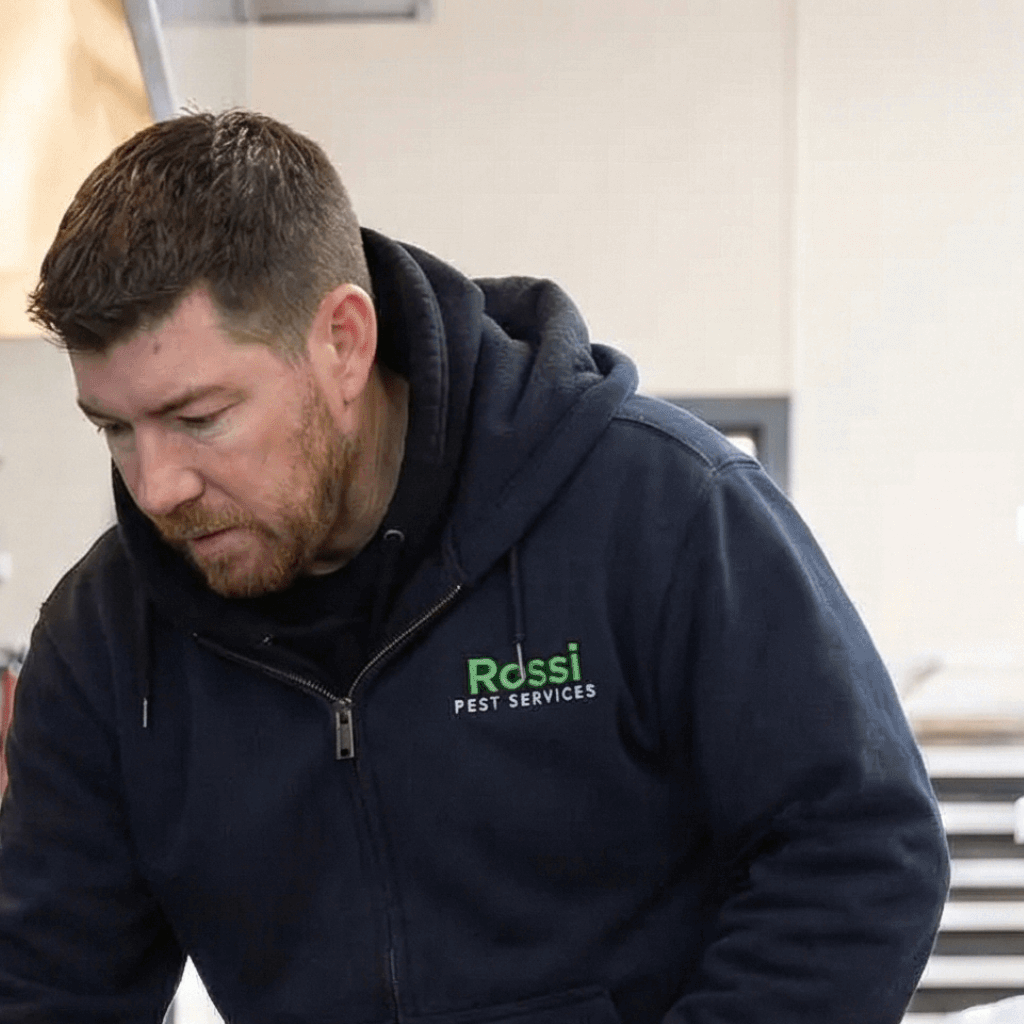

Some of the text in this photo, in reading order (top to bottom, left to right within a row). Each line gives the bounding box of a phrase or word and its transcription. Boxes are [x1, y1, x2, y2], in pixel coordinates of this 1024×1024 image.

[468, 642, 581, 695] Rossi
[454, 684, 596, 714] PEST SERVICES
